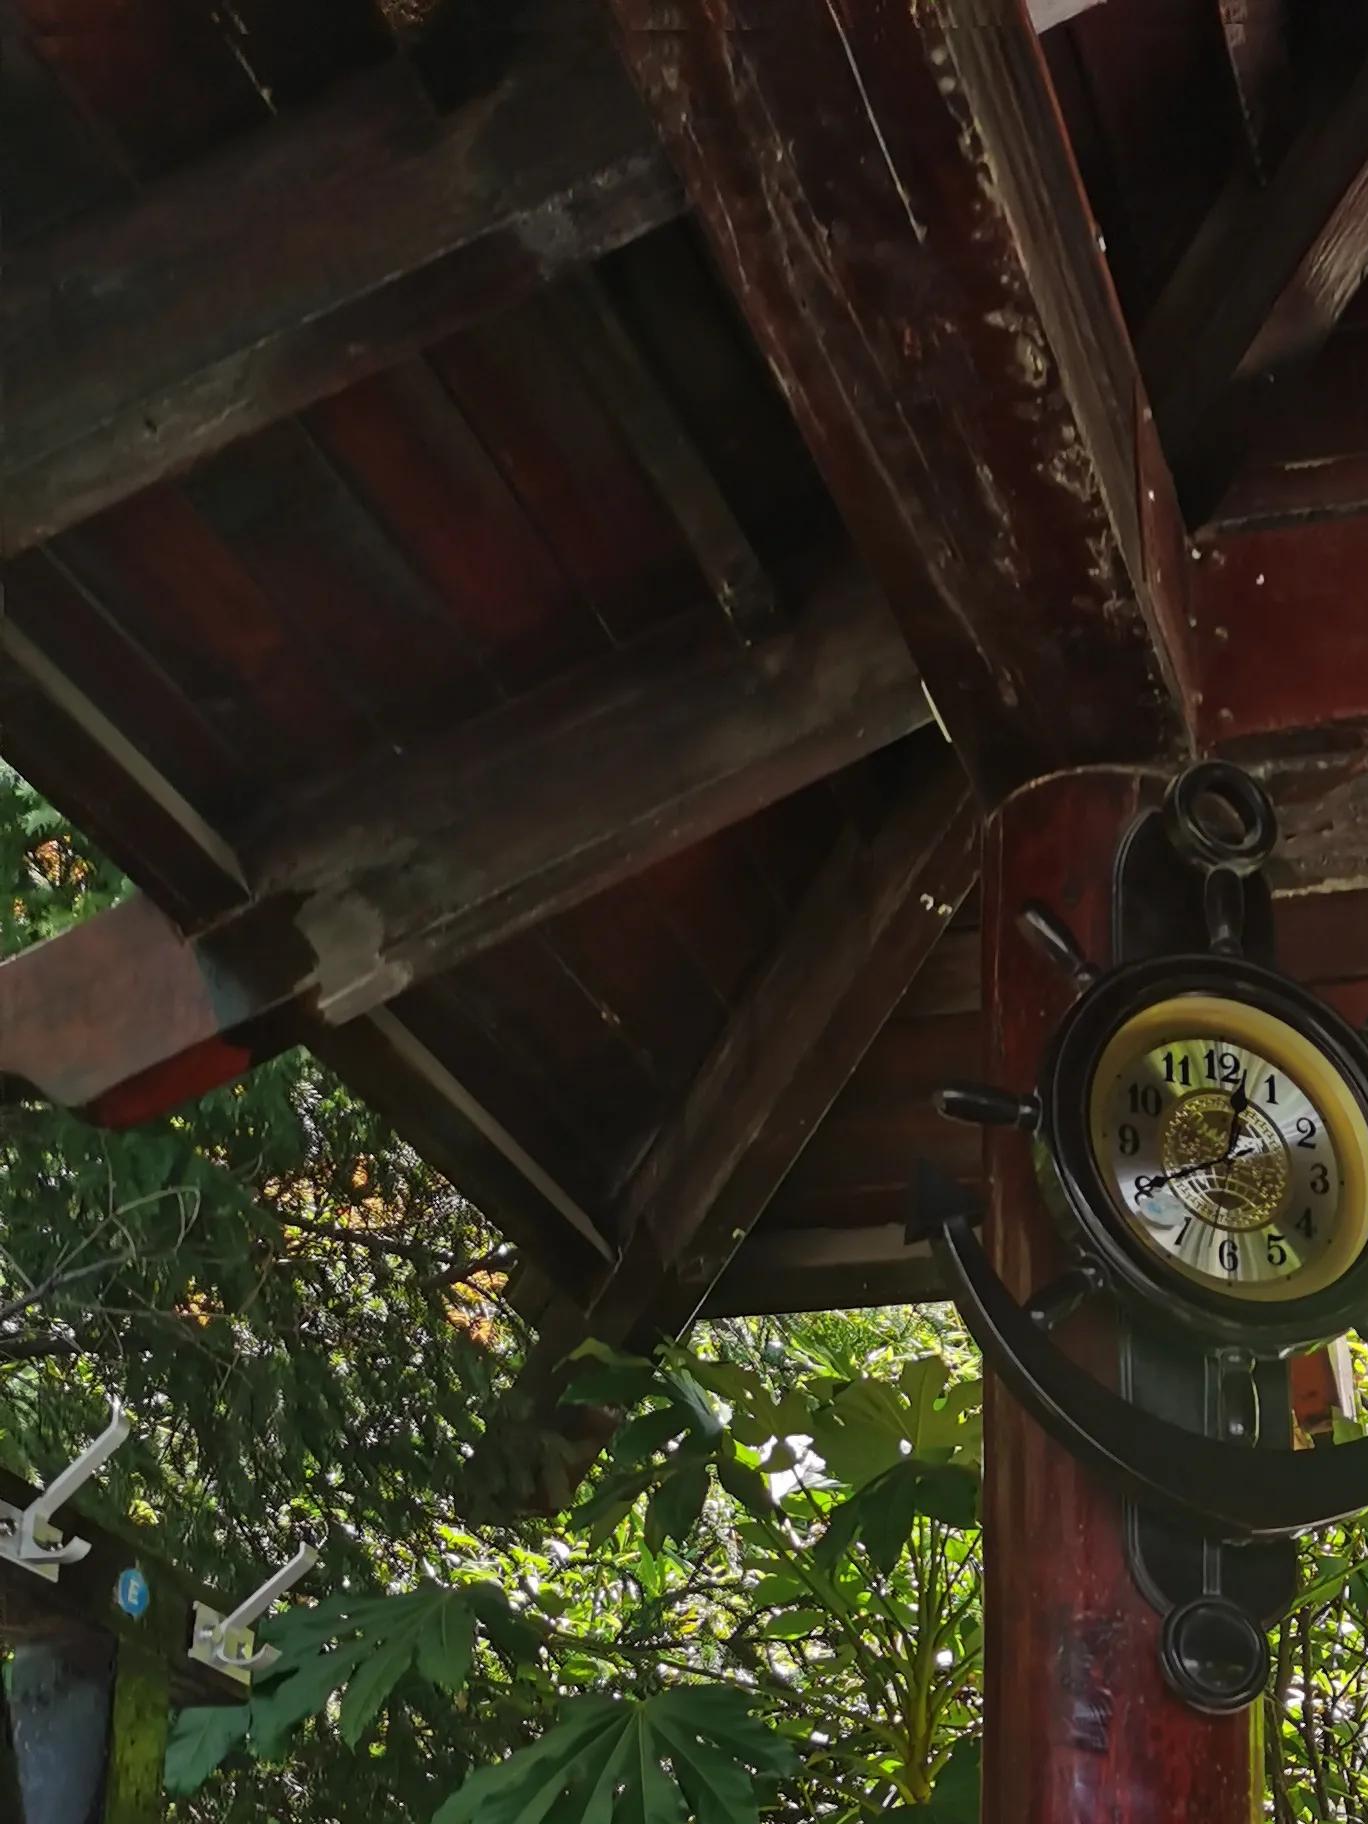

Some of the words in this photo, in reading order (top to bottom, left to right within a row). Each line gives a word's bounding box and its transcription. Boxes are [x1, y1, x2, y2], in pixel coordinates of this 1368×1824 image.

[1162, 1052, 1191, 1086] 11
[1204, 1049, 1240, 1084] 12
[1128, 1083, 1162, 1116] 10
[1264, 1075, 1279, 1104] 1
[1118, 1124, 1140, 1154] 9
[1295, 1118, 1317, 1149] 2
[1309, 1164, 1329, 1194] 3
[1295, 1208, 1317, 1238] 4
[1218, 1239, 1238, 1271] 6
[1267, 1234, 1287, 1266] 5
